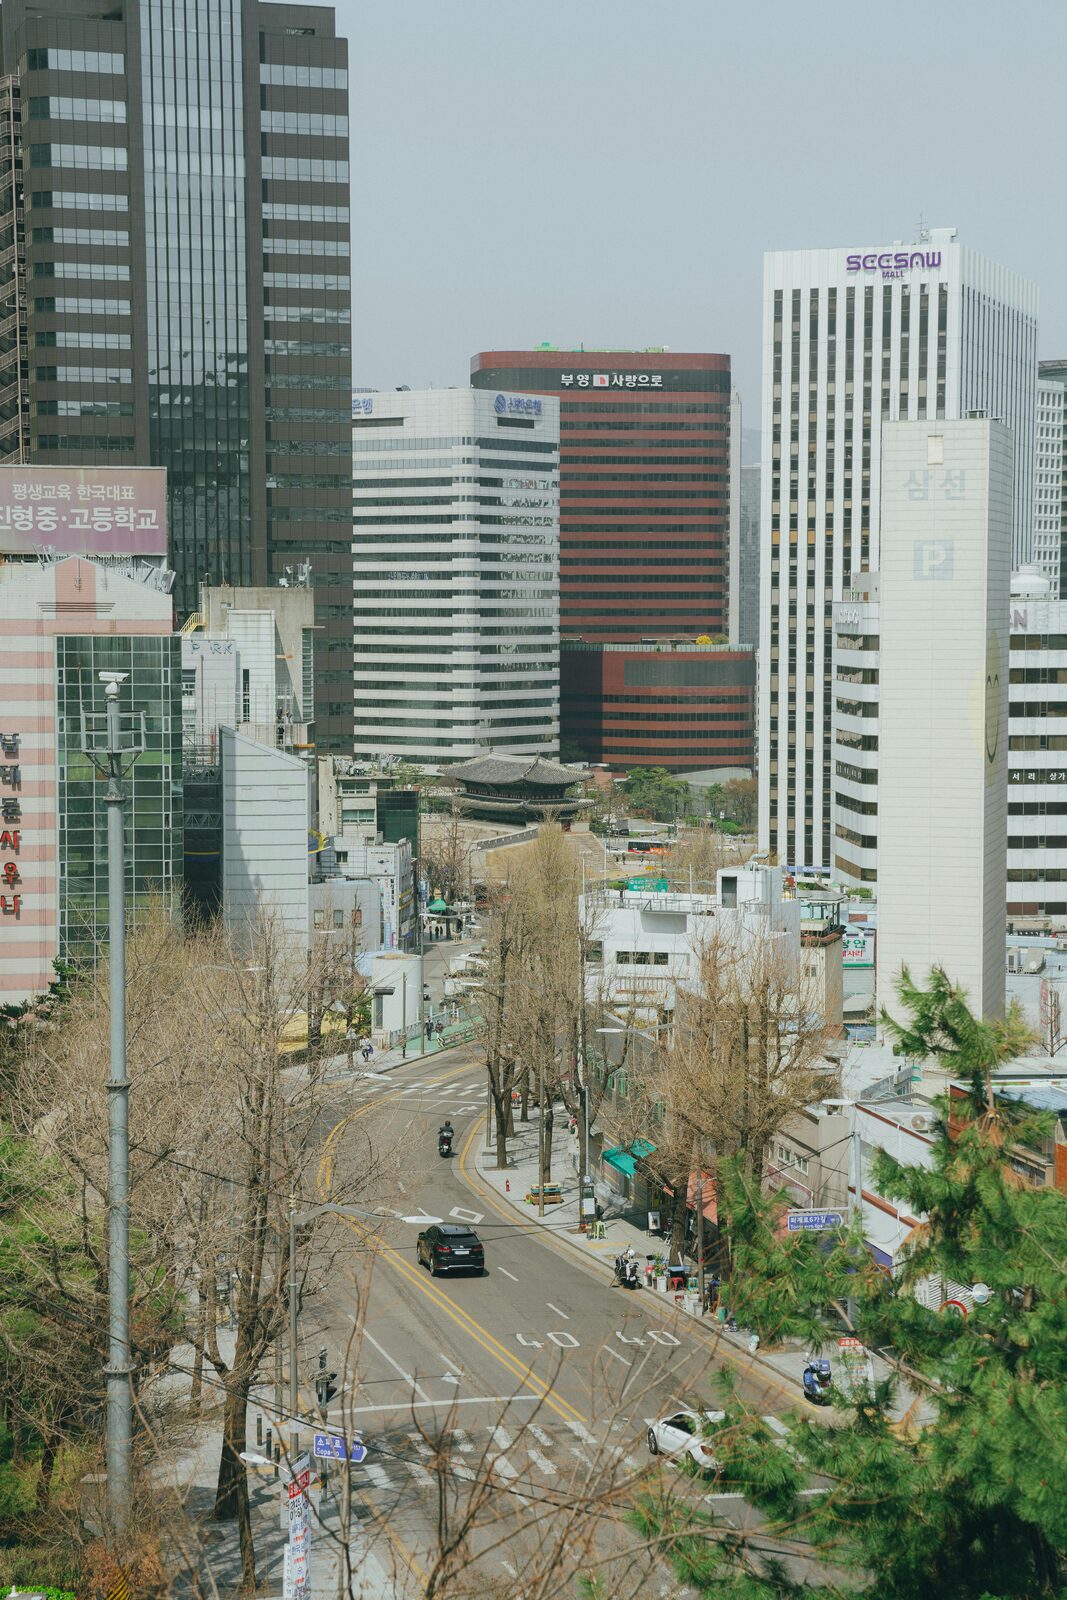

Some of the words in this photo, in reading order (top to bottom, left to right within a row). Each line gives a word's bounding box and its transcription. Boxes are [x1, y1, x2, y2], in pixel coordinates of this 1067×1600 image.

[846, 252, 941, 271] SEESAW
[561, 374, 590, 387] 부영
[612, 373, 663, 387] 사랑으로
[12, 483, 72, 501] 평생교육
[76, 484, 136, 501] 한국대표
[922, 544, 946, 576] P
[516, 1332, 581, 1348] 40
[615, 1330, 682, 1346] 40
[316, 1447, 340, 1457] Sopa-o
